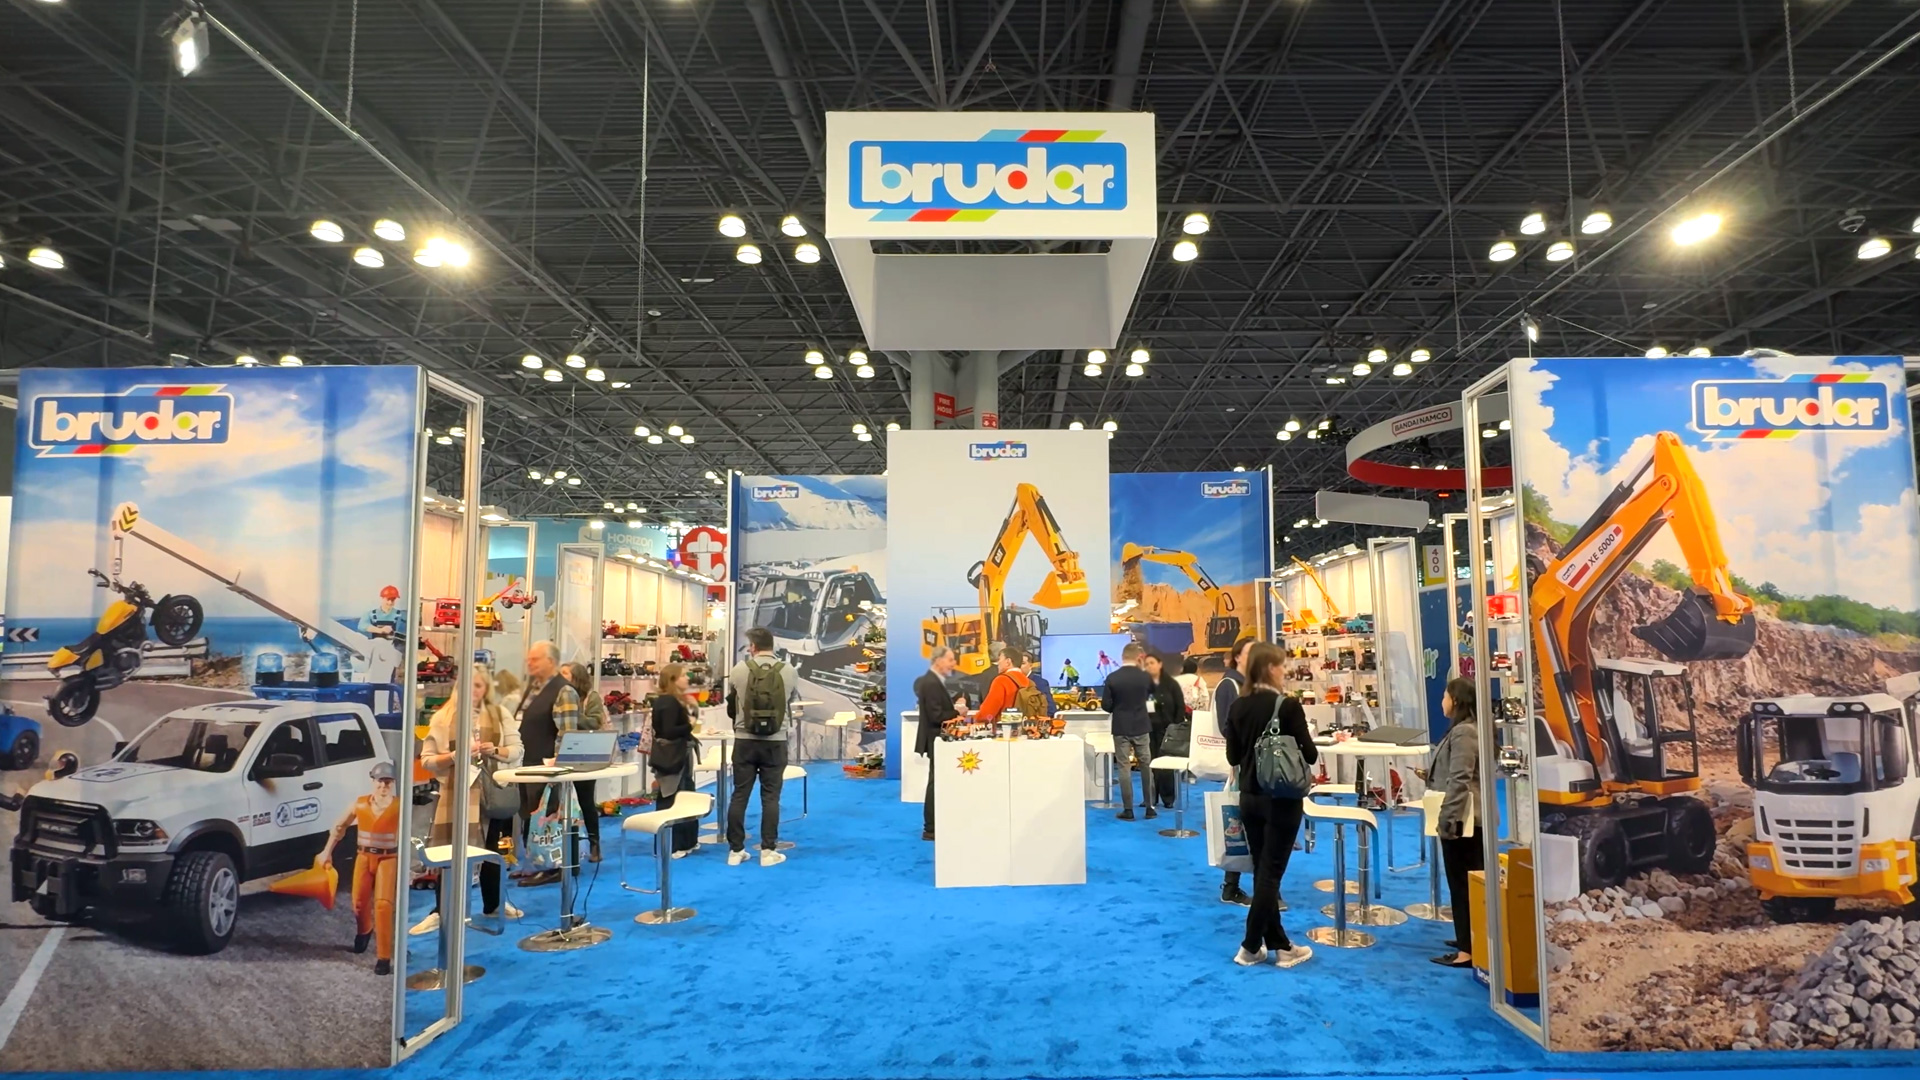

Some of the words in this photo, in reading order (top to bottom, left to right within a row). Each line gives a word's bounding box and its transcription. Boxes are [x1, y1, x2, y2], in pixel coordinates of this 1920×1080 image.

[861, 146, 1115, 204] bruder
[936, 405, 953, 415] HOSE
[1704, 385, 1880, 426] bruder
[40, 399, 222, 442] bruder
[1394, 419, 1420, 432] BANDAI
[1419, 411, 1449, 424] NAMCO
[971, 444, 1025, 458] bruder
[753, 487, 798, 498] bruder
[1203, 483, 1248, 495] bruder
[1587, 552, 1600, 567] XE
[1597, 533, 1615, 556] 5000
